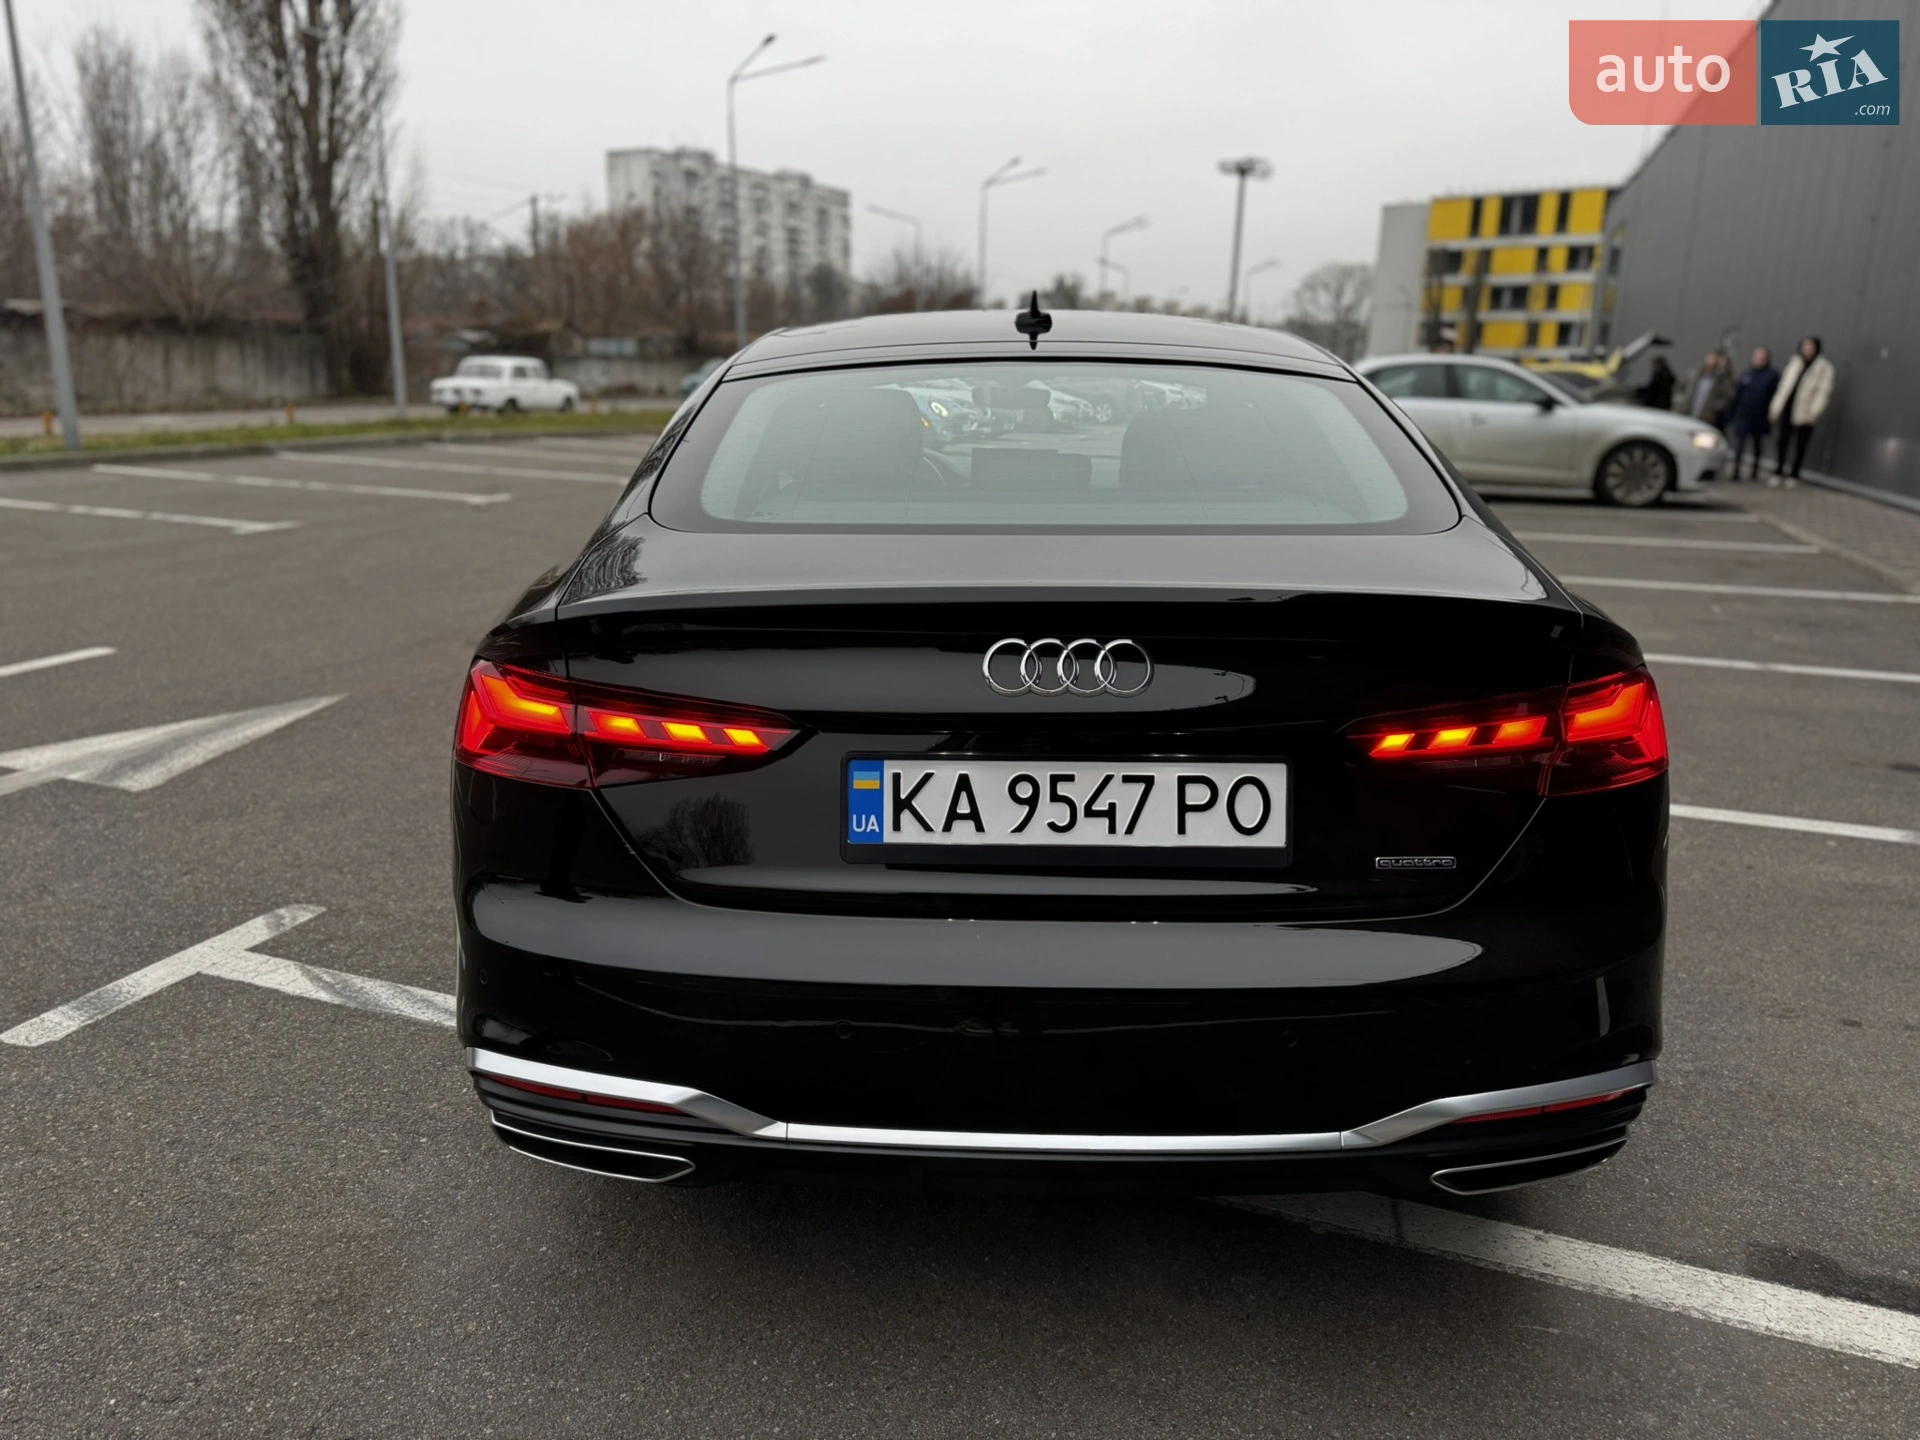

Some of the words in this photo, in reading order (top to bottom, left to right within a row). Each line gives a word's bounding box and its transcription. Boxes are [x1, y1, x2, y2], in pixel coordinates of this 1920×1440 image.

[891, 771, 986, 833] KA
[1007, 773, 1155, 834] 9547
[1176, 774, 1271, 836] PO
[852, 814, 880, 833] UA
[1379, 858, 1453, 868] quattro
